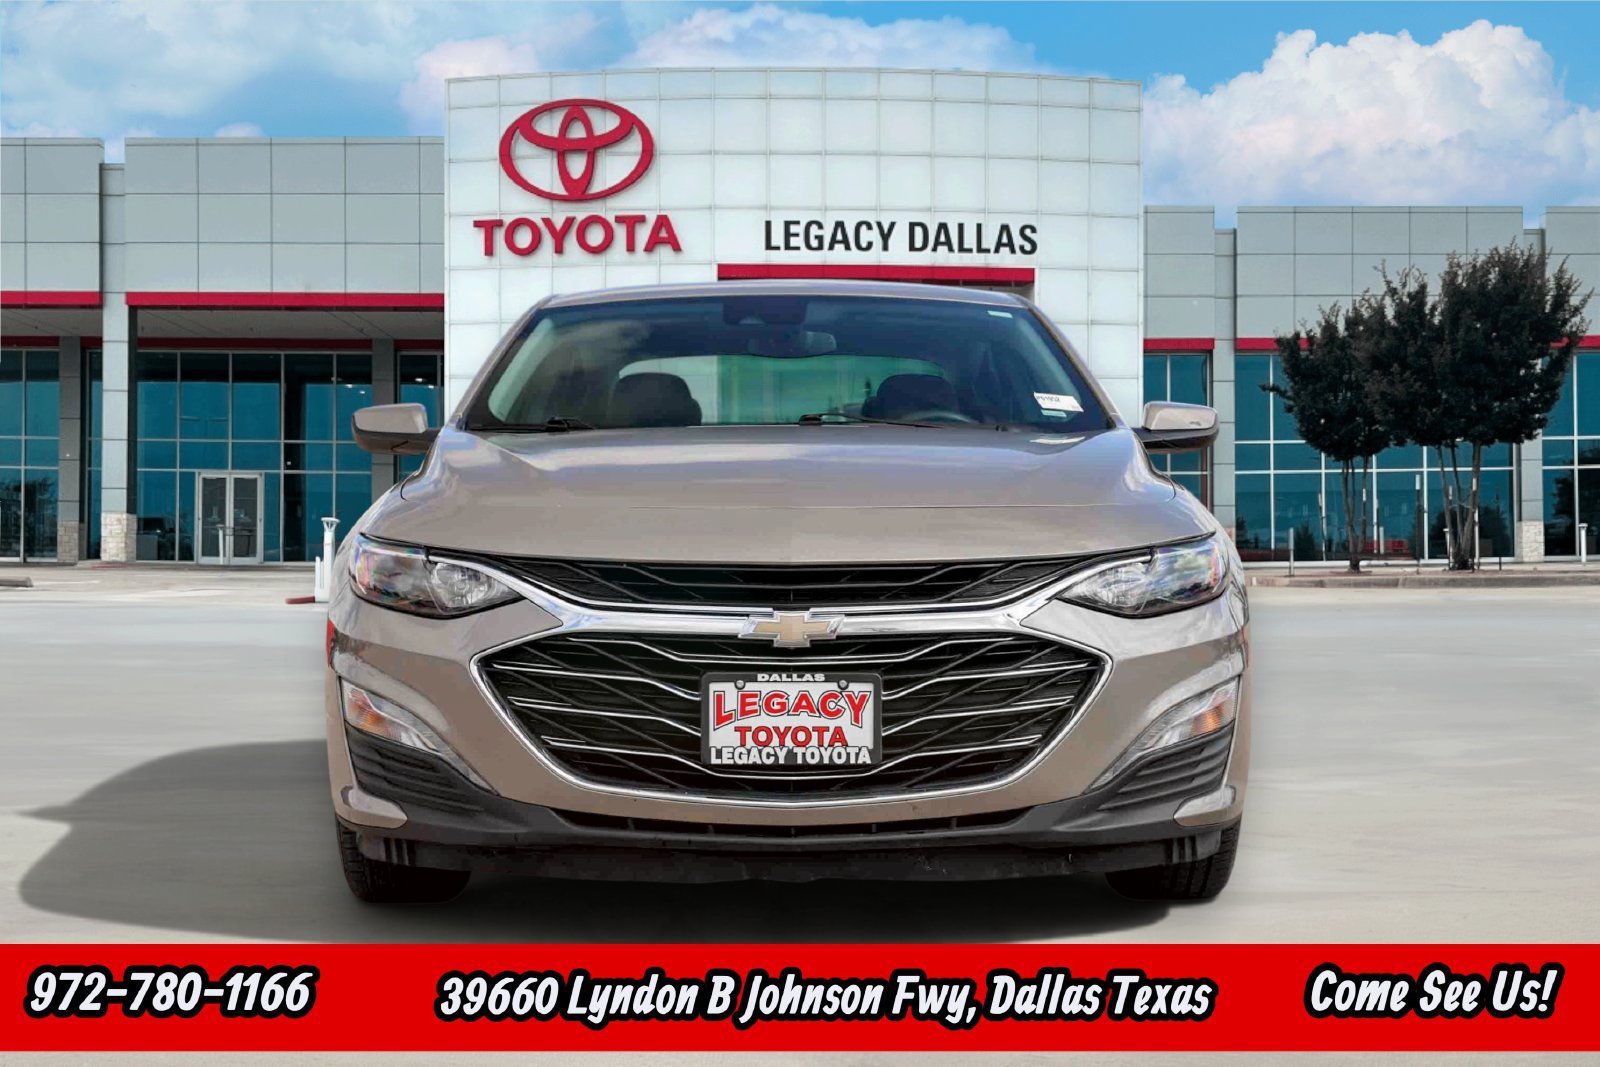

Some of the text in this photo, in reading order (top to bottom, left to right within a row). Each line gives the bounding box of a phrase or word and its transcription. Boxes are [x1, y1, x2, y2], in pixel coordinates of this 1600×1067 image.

[475, 214, 681, 256] TOYOTA
[765, 220, 1038, 255] LEGACY DALLAS
[757, 673, 826, 682] DALLAS
[713, 690, 872, 731] LEGACY
[734, 725, 849, 747] TOYOTA
[710, 746, 872, 765] LEGACY TOYOTA
